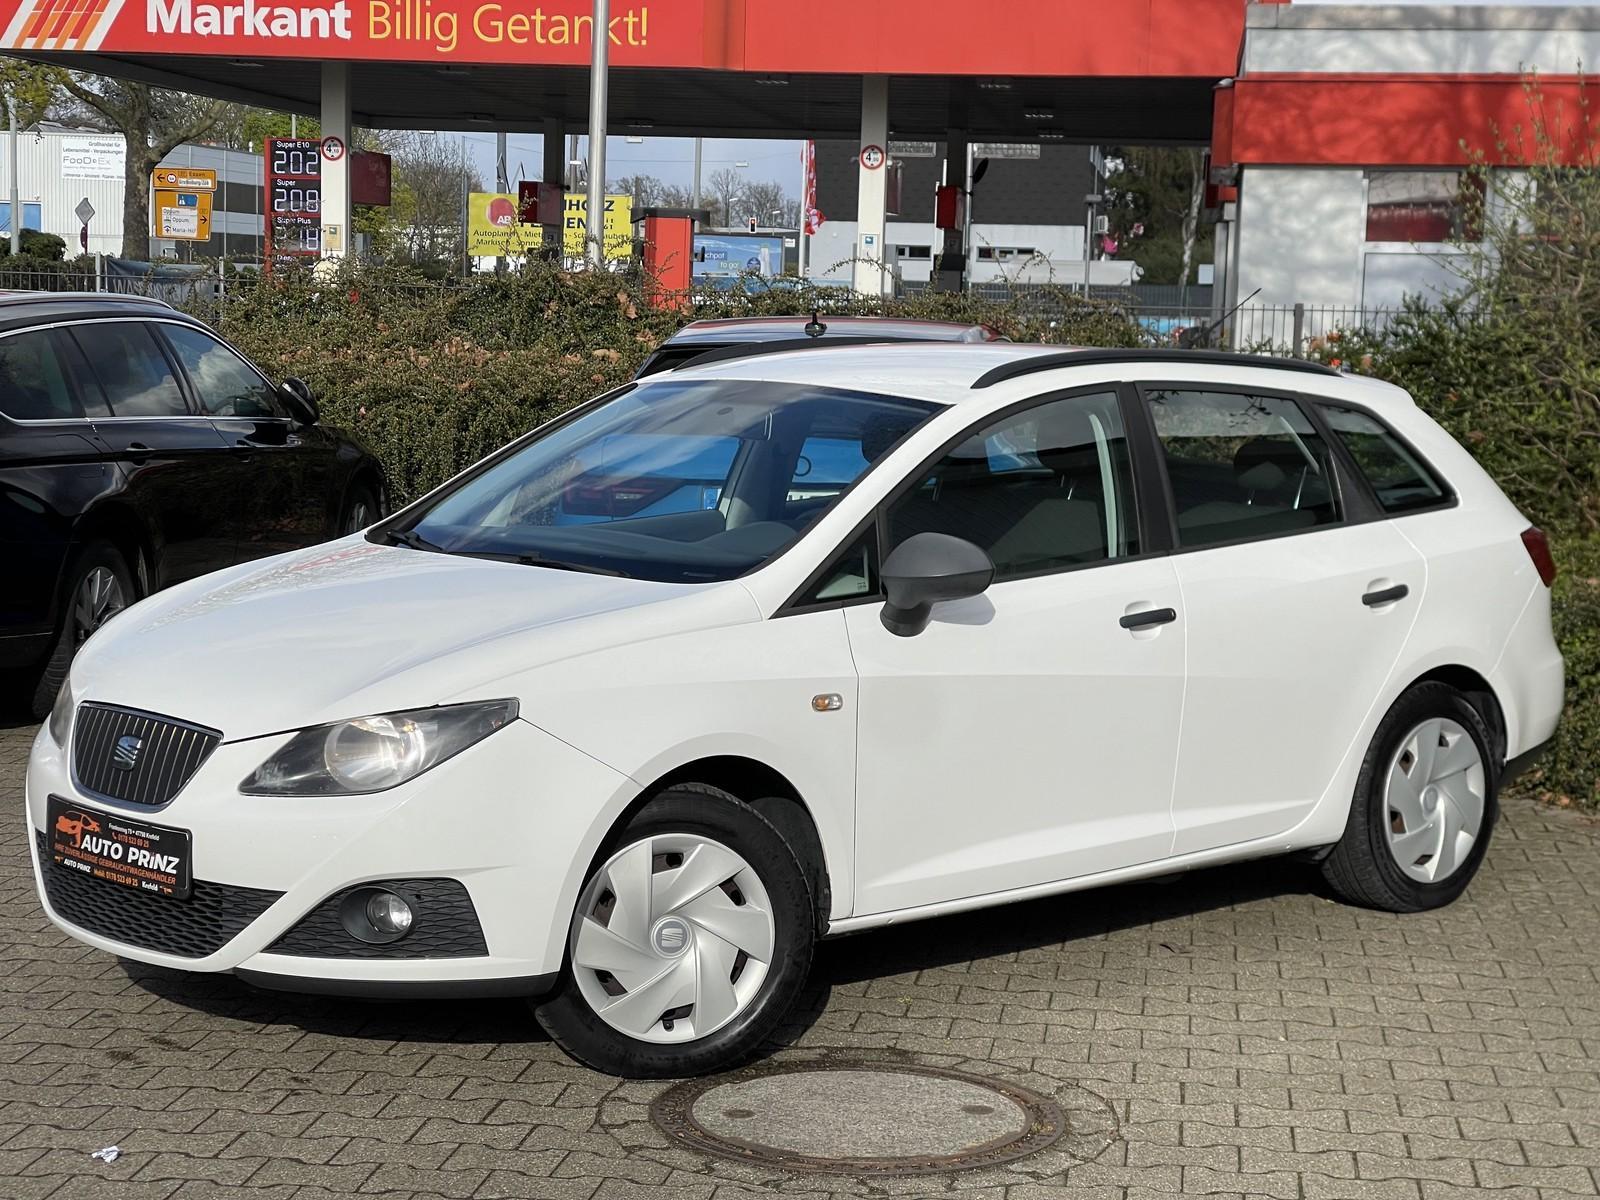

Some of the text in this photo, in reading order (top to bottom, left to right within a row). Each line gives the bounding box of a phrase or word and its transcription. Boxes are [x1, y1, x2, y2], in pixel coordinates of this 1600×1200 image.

[146, 0, 648, 52] Markant Billig Getankt!
[276, 141, 296, 149] Super
[274, 151, 319, 174] 202
[276, 179, 296, 187] Super
[274, 189, 319, 213] 208
[297, 217, 312, 225] Plus
[81, 834, 123, 860] AUTO
[63, 858, 77, 869] AUTO
